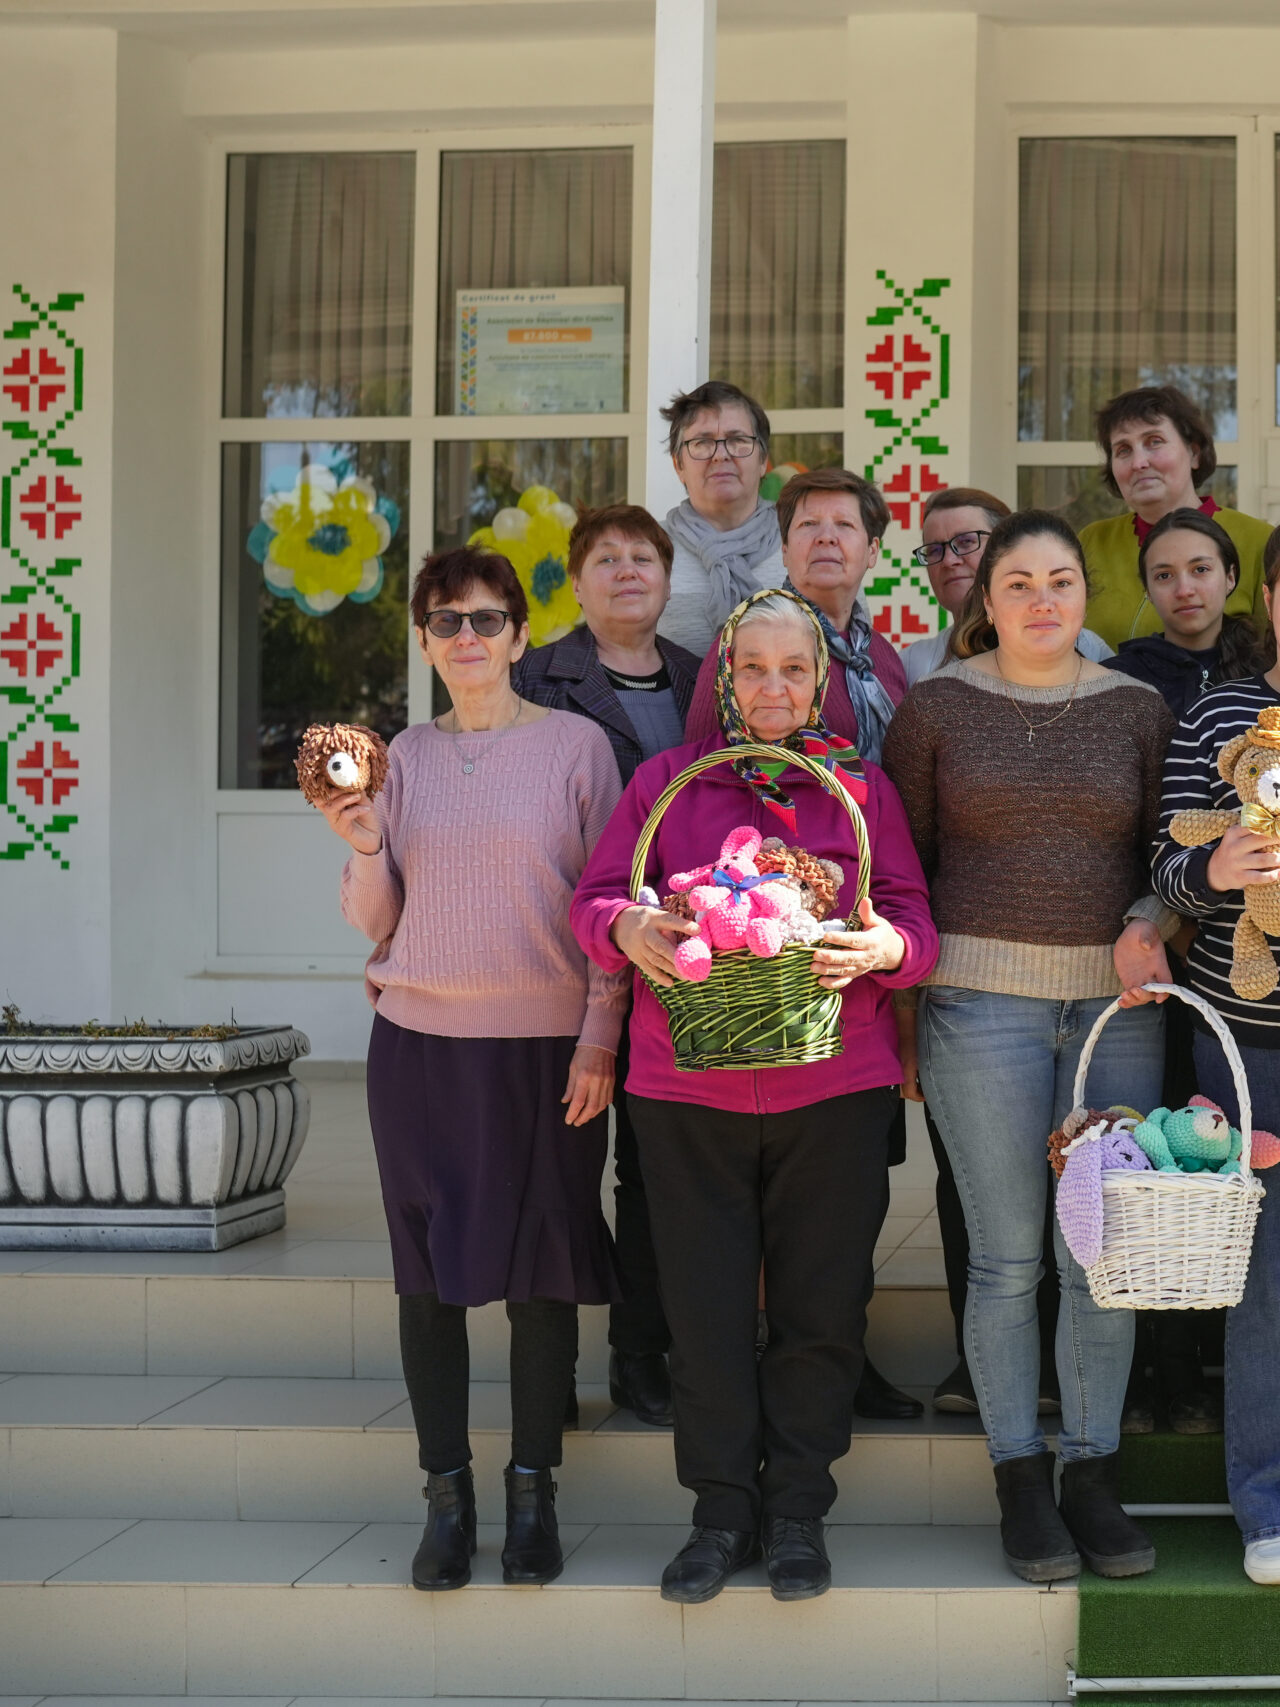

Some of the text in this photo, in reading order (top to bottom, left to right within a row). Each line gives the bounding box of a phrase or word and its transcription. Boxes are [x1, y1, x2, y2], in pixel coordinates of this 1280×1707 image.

[462, 292, 556, 304] Certificat de grant
